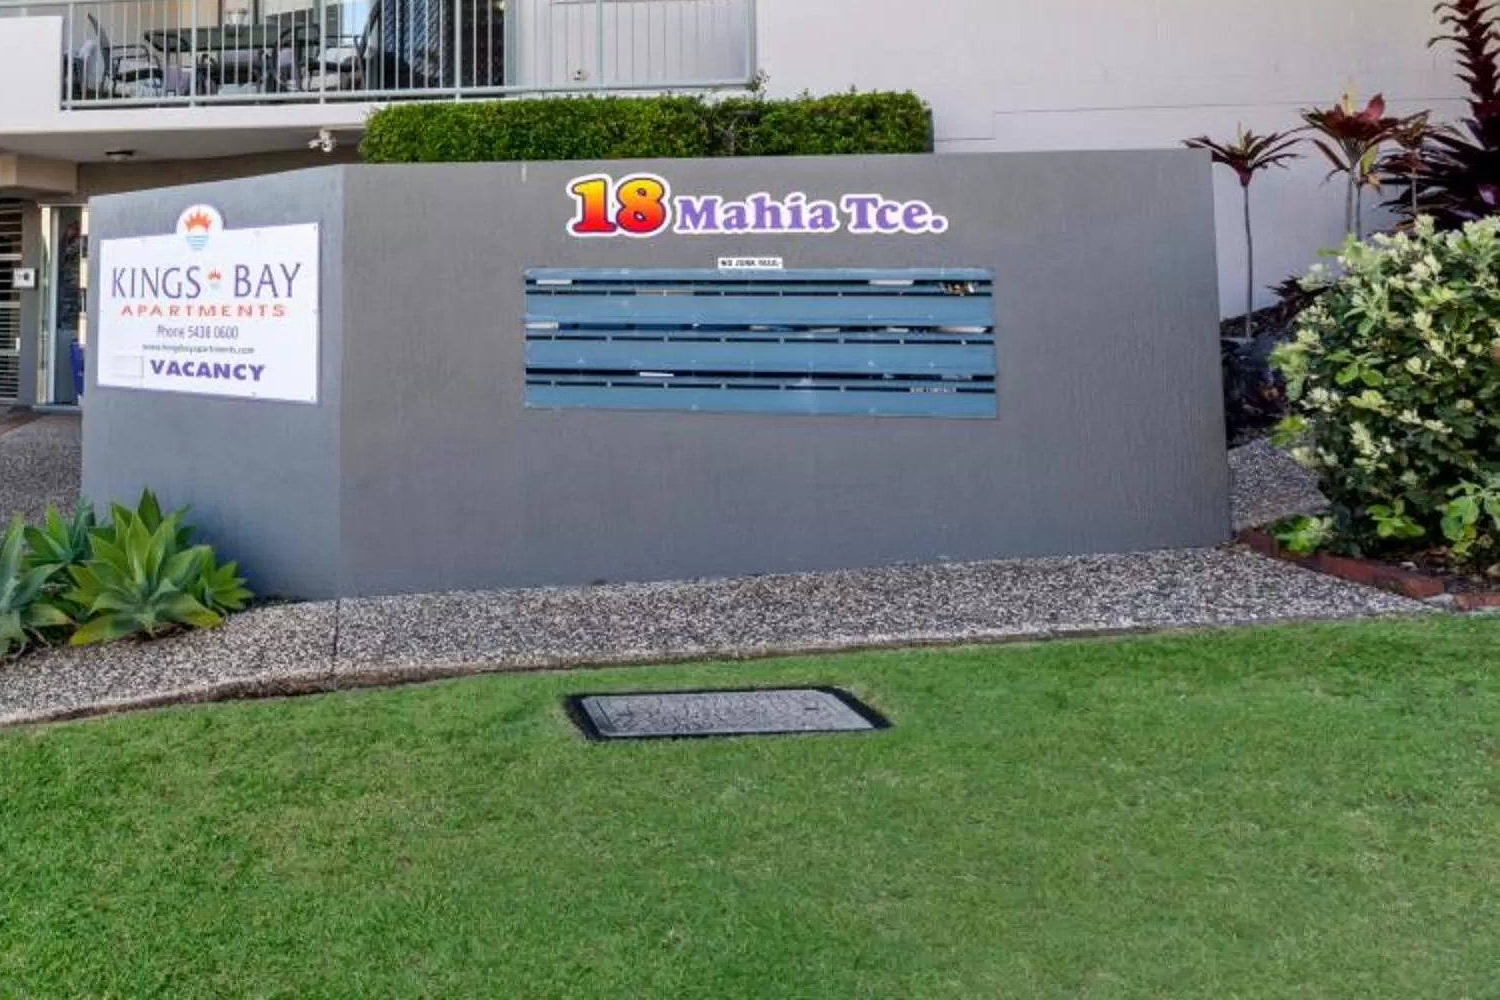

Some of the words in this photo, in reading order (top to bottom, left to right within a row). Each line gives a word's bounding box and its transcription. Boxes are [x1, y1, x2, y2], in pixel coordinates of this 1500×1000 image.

[571, 176, 667, 234] 18
[678, 194, 835, 232] Mahia
[845, 196, 946, 232] Tce.
[111, 265, 201, 299] KINGS
[233, 262, 301, 298] BAY
[120, 303, 287, 317] APARTMENTS
[156, 323, 185, 338] Phone
[149, 359, 265, 381] VACANCY
